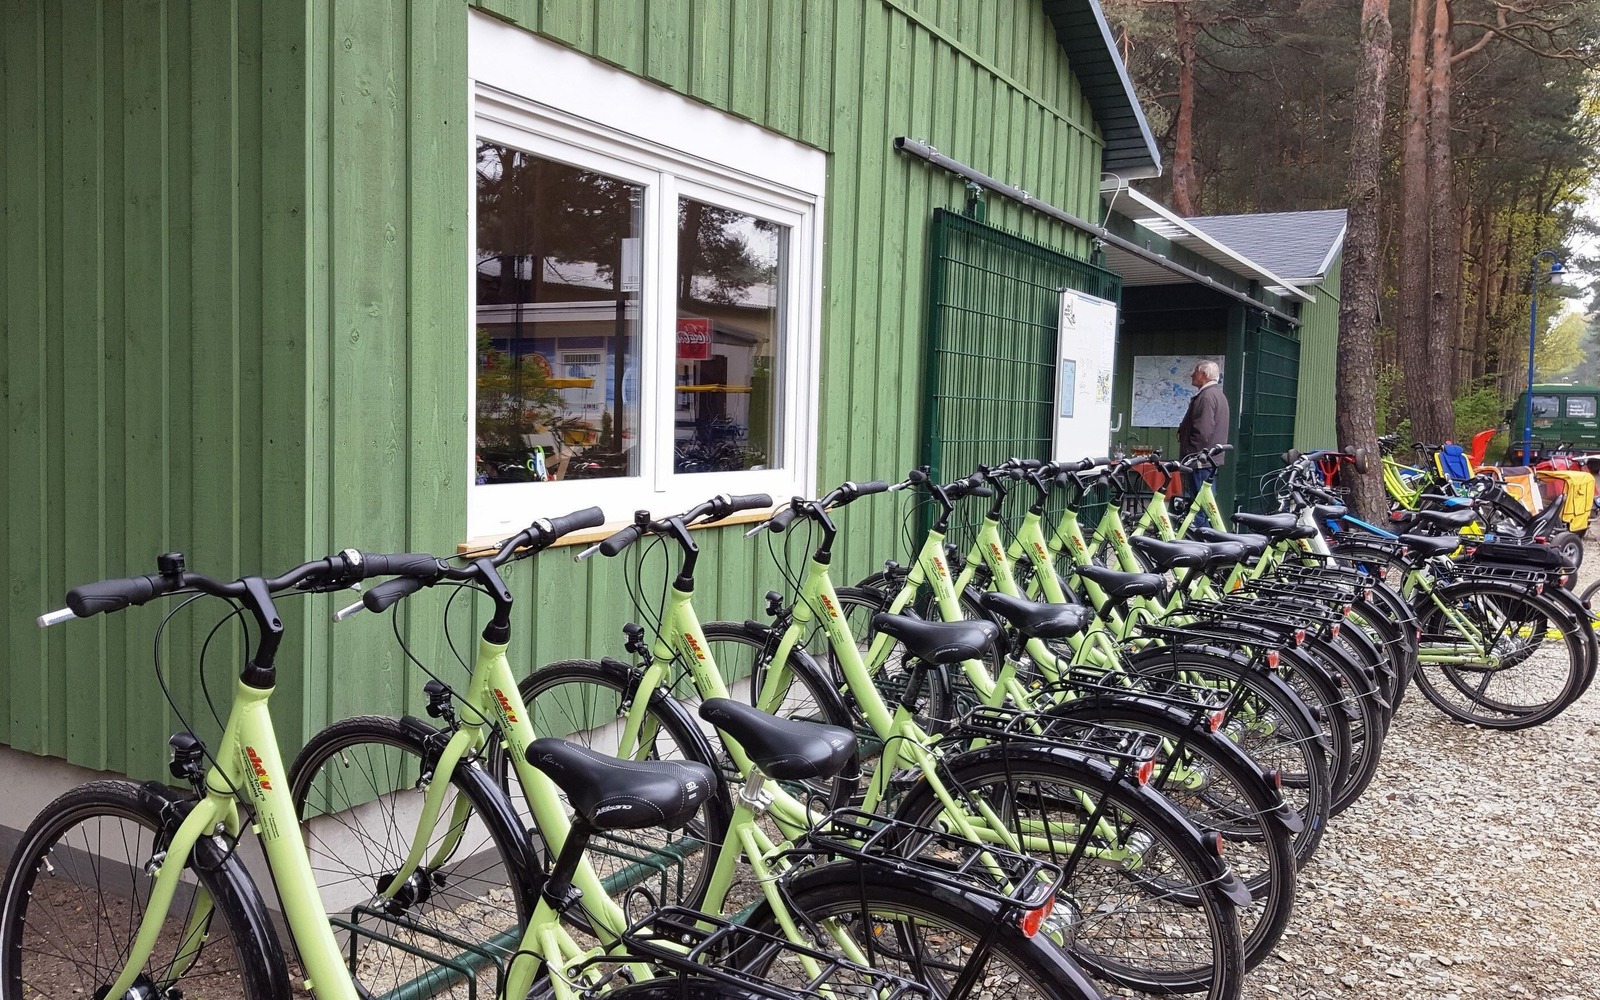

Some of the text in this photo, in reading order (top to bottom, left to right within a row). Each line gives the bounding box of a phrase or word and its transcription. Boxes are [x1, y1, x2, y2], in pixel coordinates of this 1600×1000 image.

[494, 688, 518, 722] aktiv
[246, 746, 273, 790] aktiv
[254, 778, 267, 802] tours
